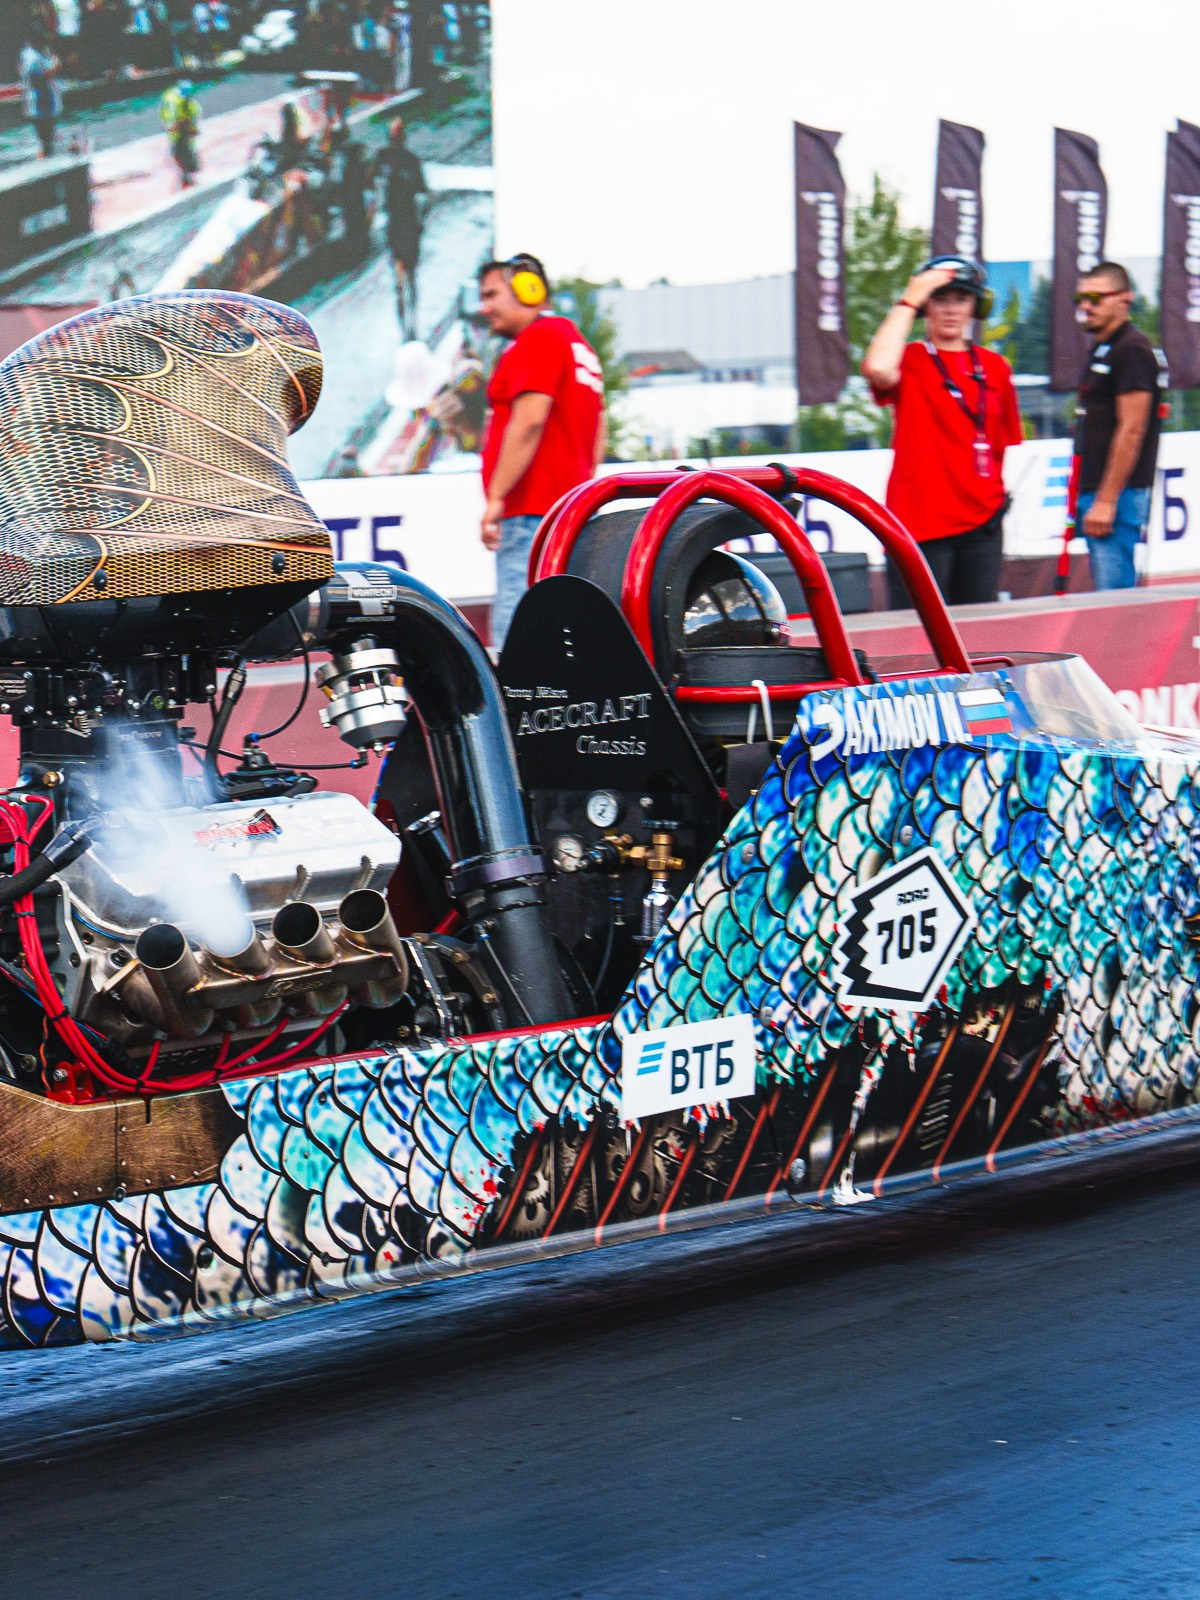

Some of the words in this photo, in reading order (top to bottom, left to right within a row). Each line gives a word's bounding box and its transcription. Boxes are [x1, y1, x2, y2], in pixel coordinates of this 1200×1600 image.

[516, 693, 653, 736] ACECRAFT
[575, 734, 648, 756] Chassis
[877, 907, 938, 965] 705
[670, 1039, 735, 1095] ВТБ
